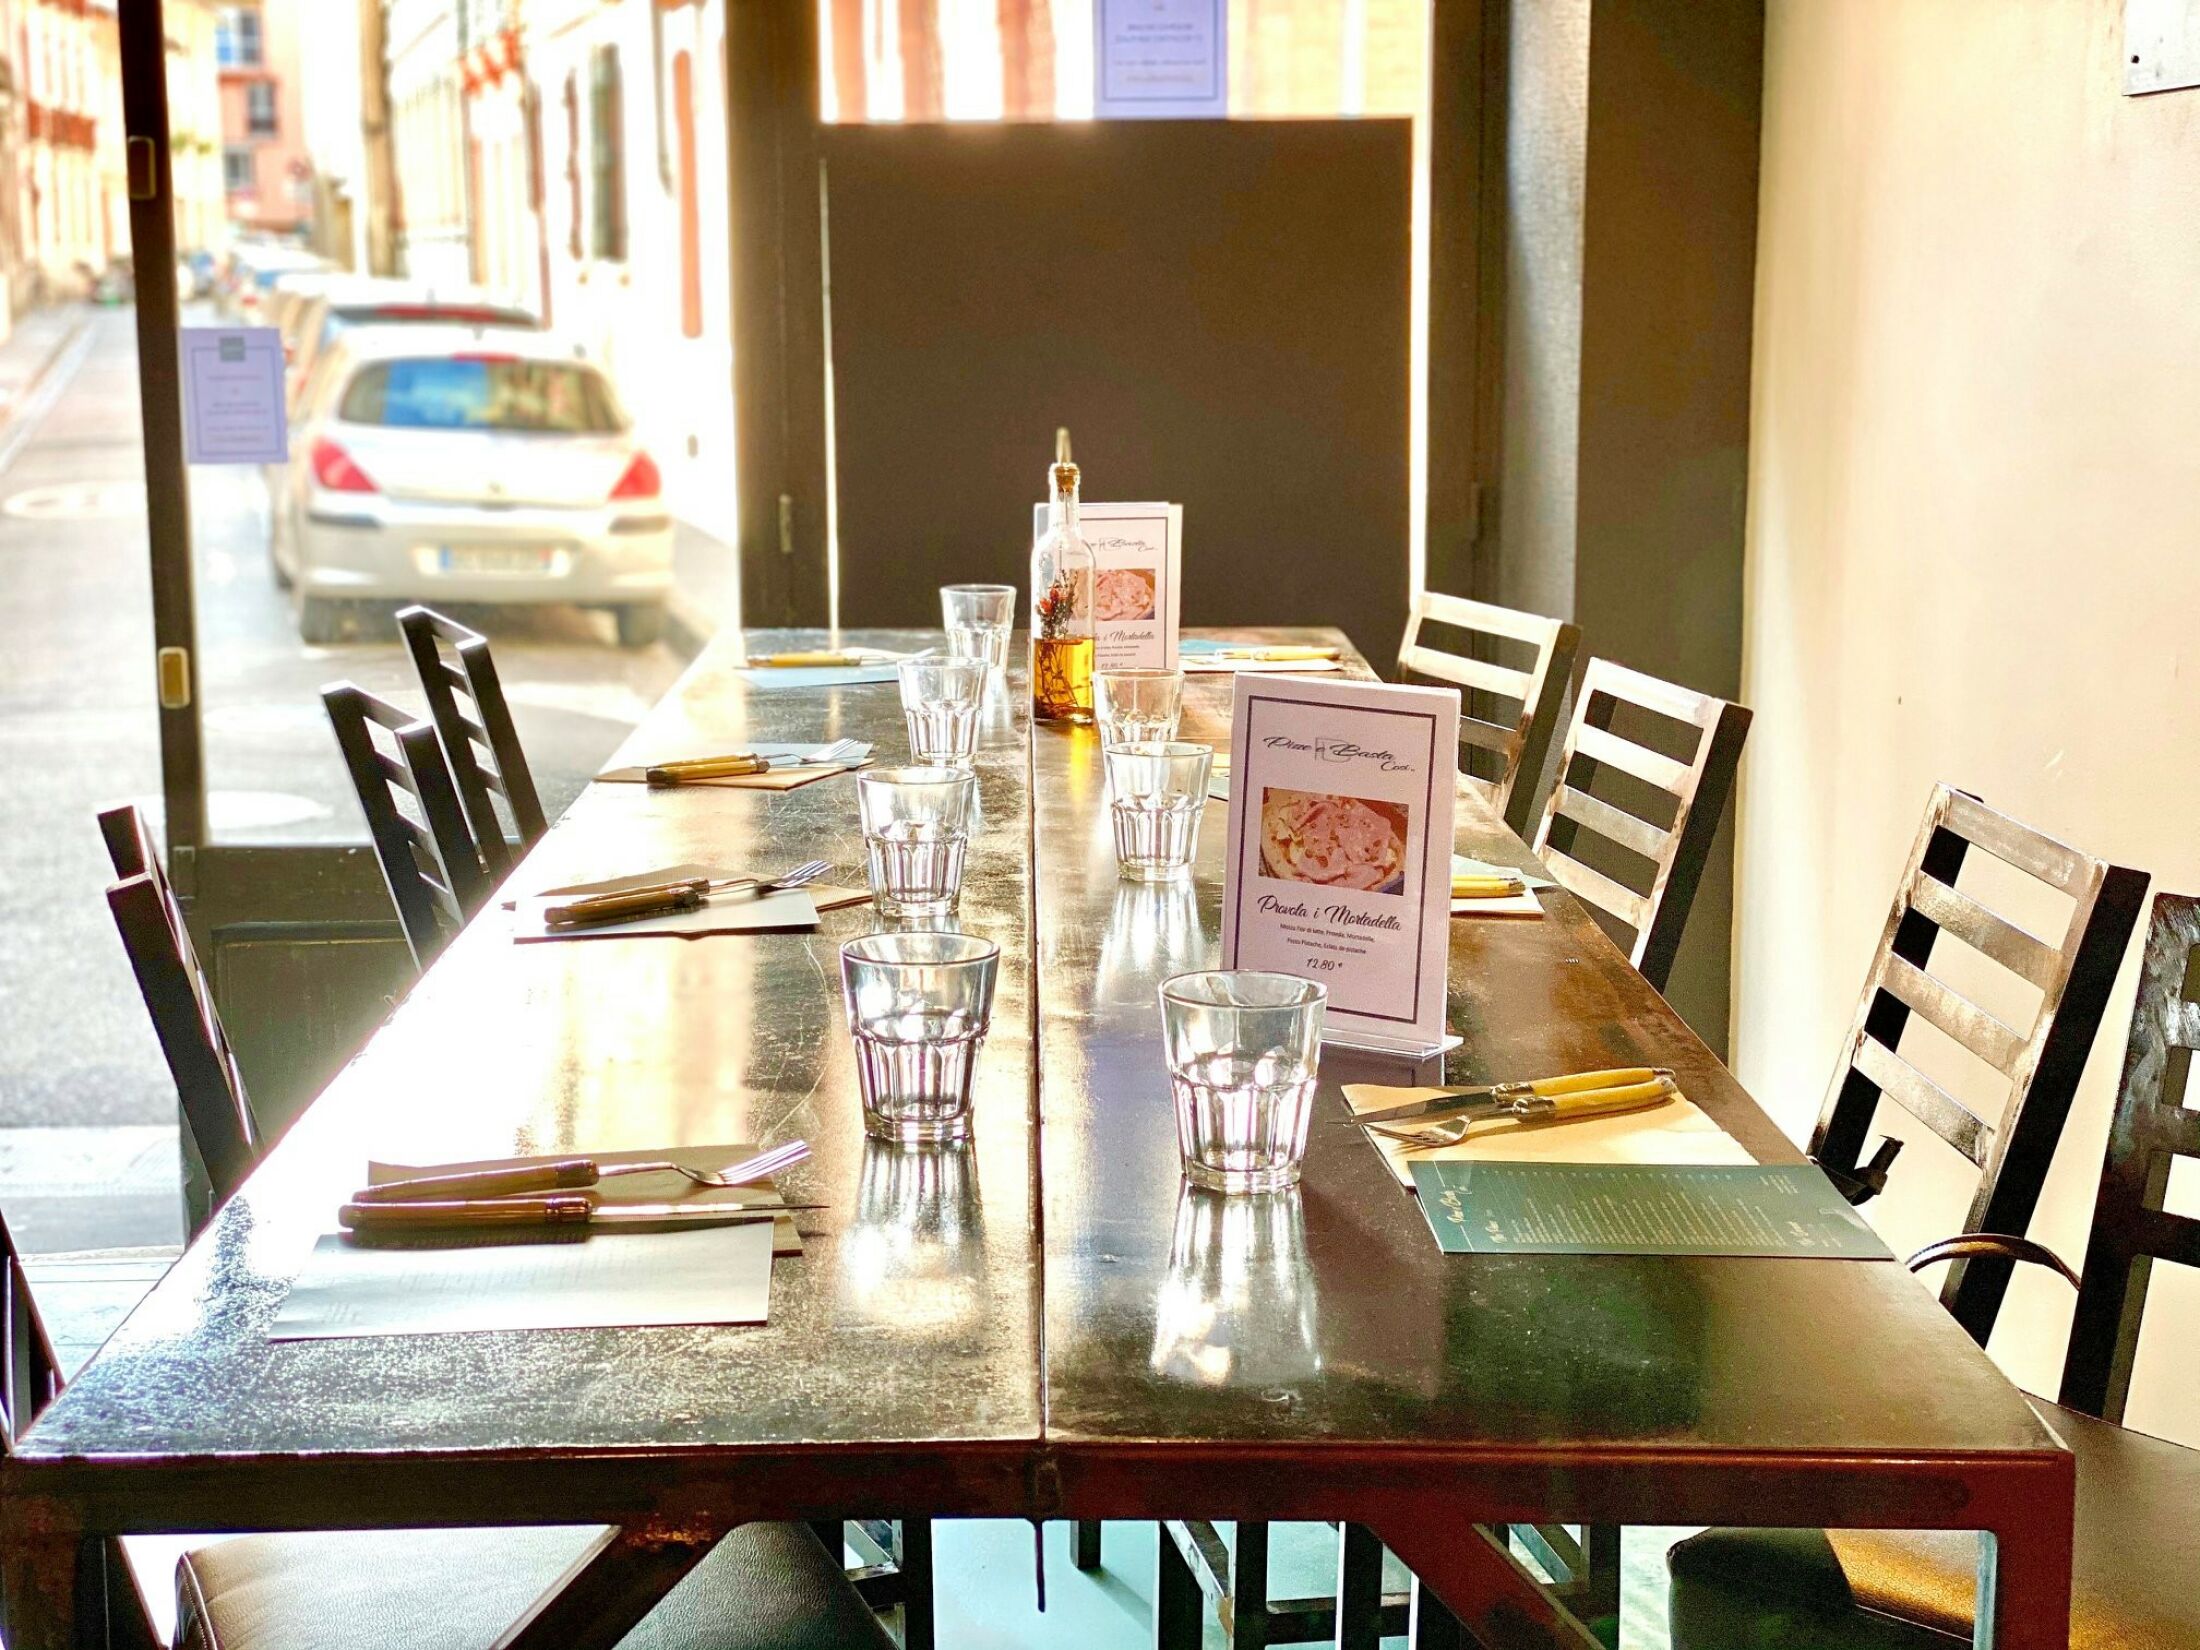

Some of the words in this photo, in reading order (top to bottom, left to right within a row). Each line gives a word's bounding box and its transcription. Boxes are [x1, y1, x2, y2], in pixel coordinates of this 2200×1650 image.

[1329, 743, 1396, 761] Basta
[1257, 895, 1309, 919] Provola
[1324, 905, 1402, 931] Mortadella
